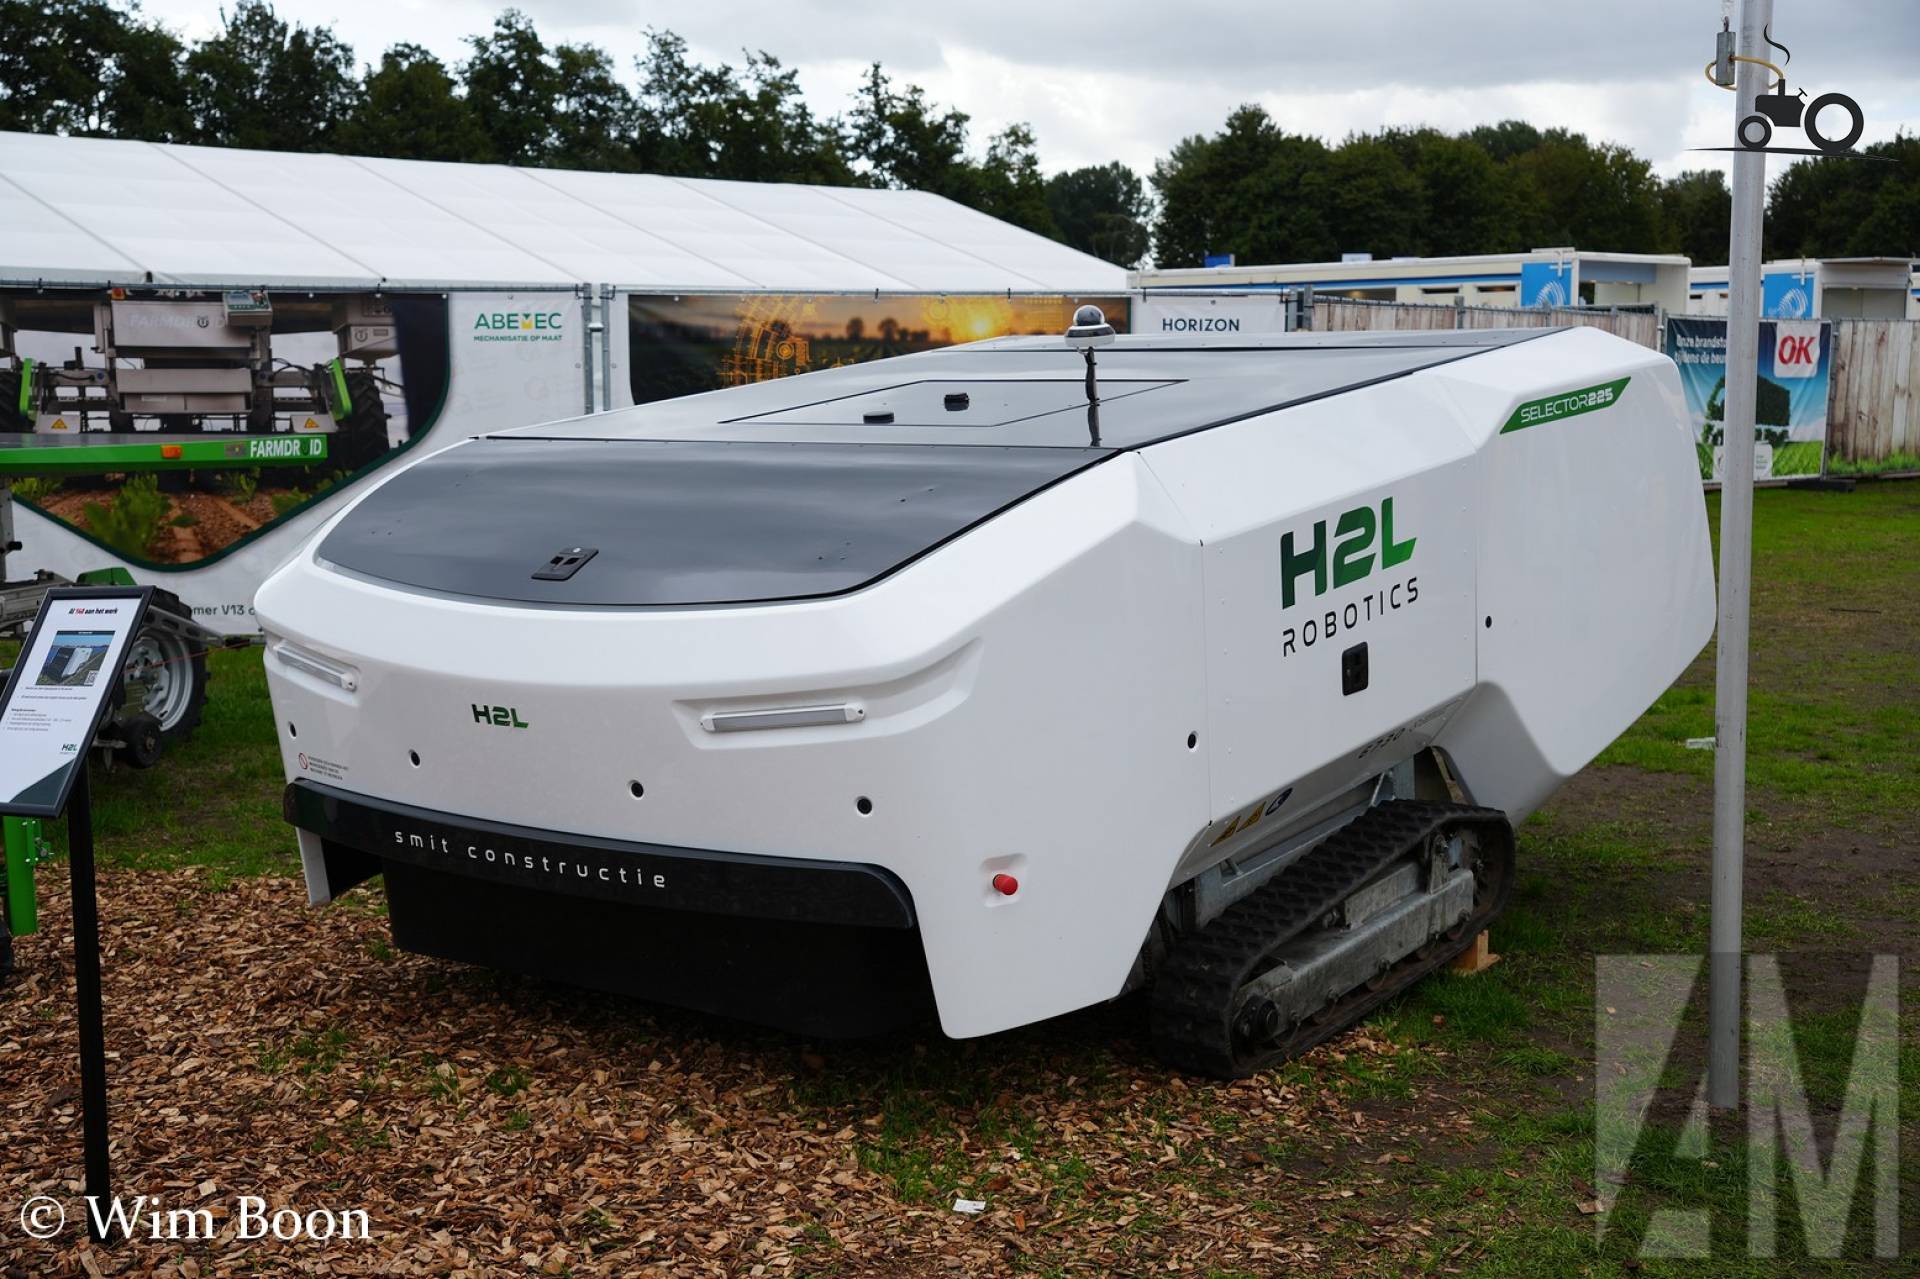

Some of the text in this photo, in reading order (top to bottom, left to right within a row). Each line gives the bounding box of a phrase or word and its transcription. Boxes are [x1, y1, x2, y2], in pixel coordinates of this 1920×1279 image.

[1162, 318, 1240, 332] HORIZON
[1778, 335, 1815, 365] OK
[1520, 387, 1614, 423] SELECTOR225
[1280, 496, 1417, 610] H2L
[221, 604, 245, 616] V13
[1282, 576, 1419, 658] ROBOTICS
[471, 704, 529, 729] H2L
[61, 744, 78, 752] H2L
[394, 830, 666, 888] smit constructie
